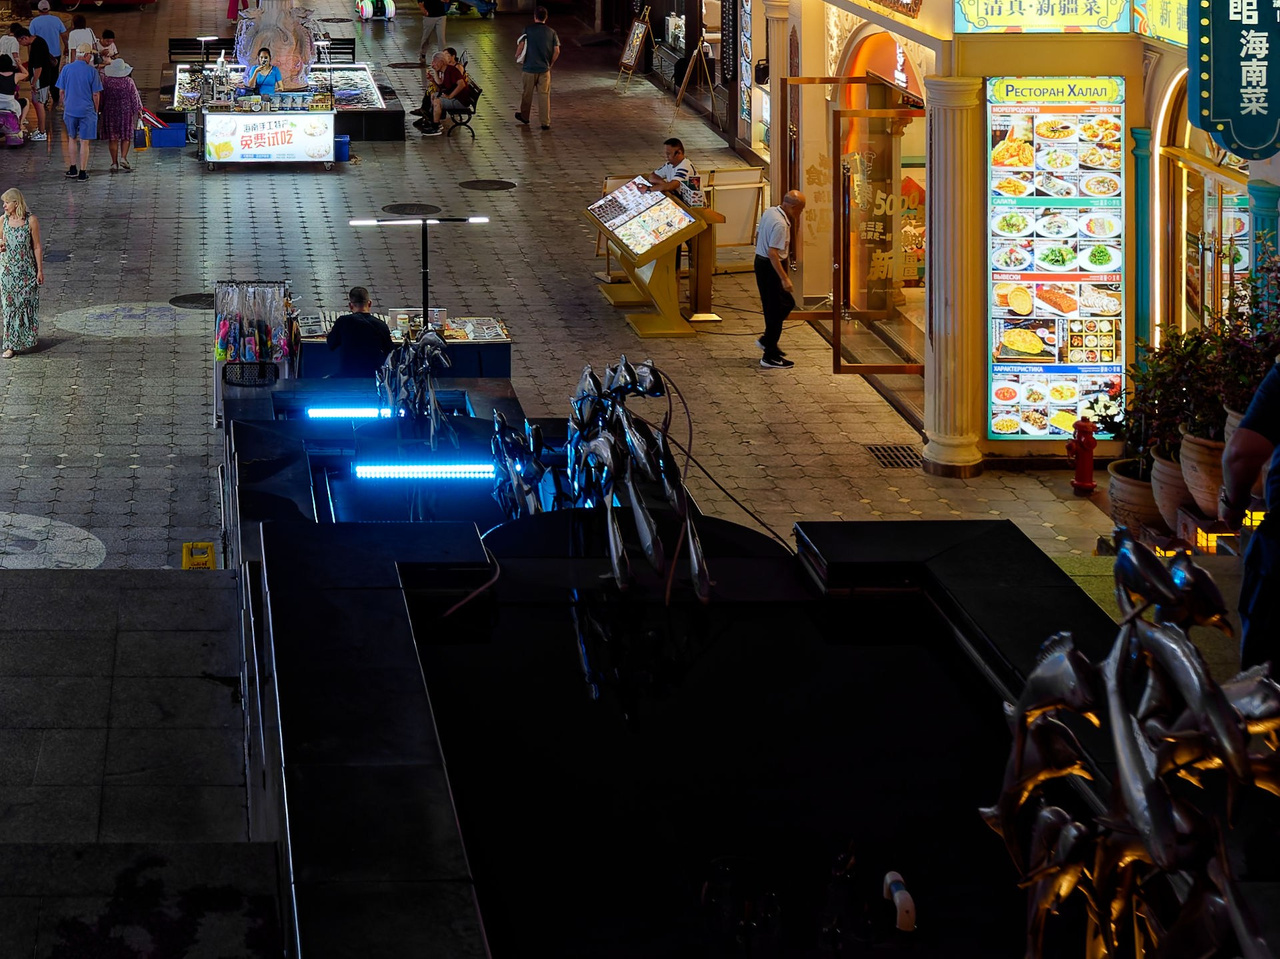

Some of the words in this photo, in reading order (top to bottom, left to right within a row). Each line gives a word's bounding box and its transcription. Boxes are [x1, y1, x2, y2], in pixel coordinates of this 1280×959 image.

[1239, 29, 1270, 116] 海南菜
[1005, 84, 1064, 97] РЕСТОРАН
[1067, 84, 1108, 97] ХАЛАЛ
[240, 130, 294, 151] 免费试吃
